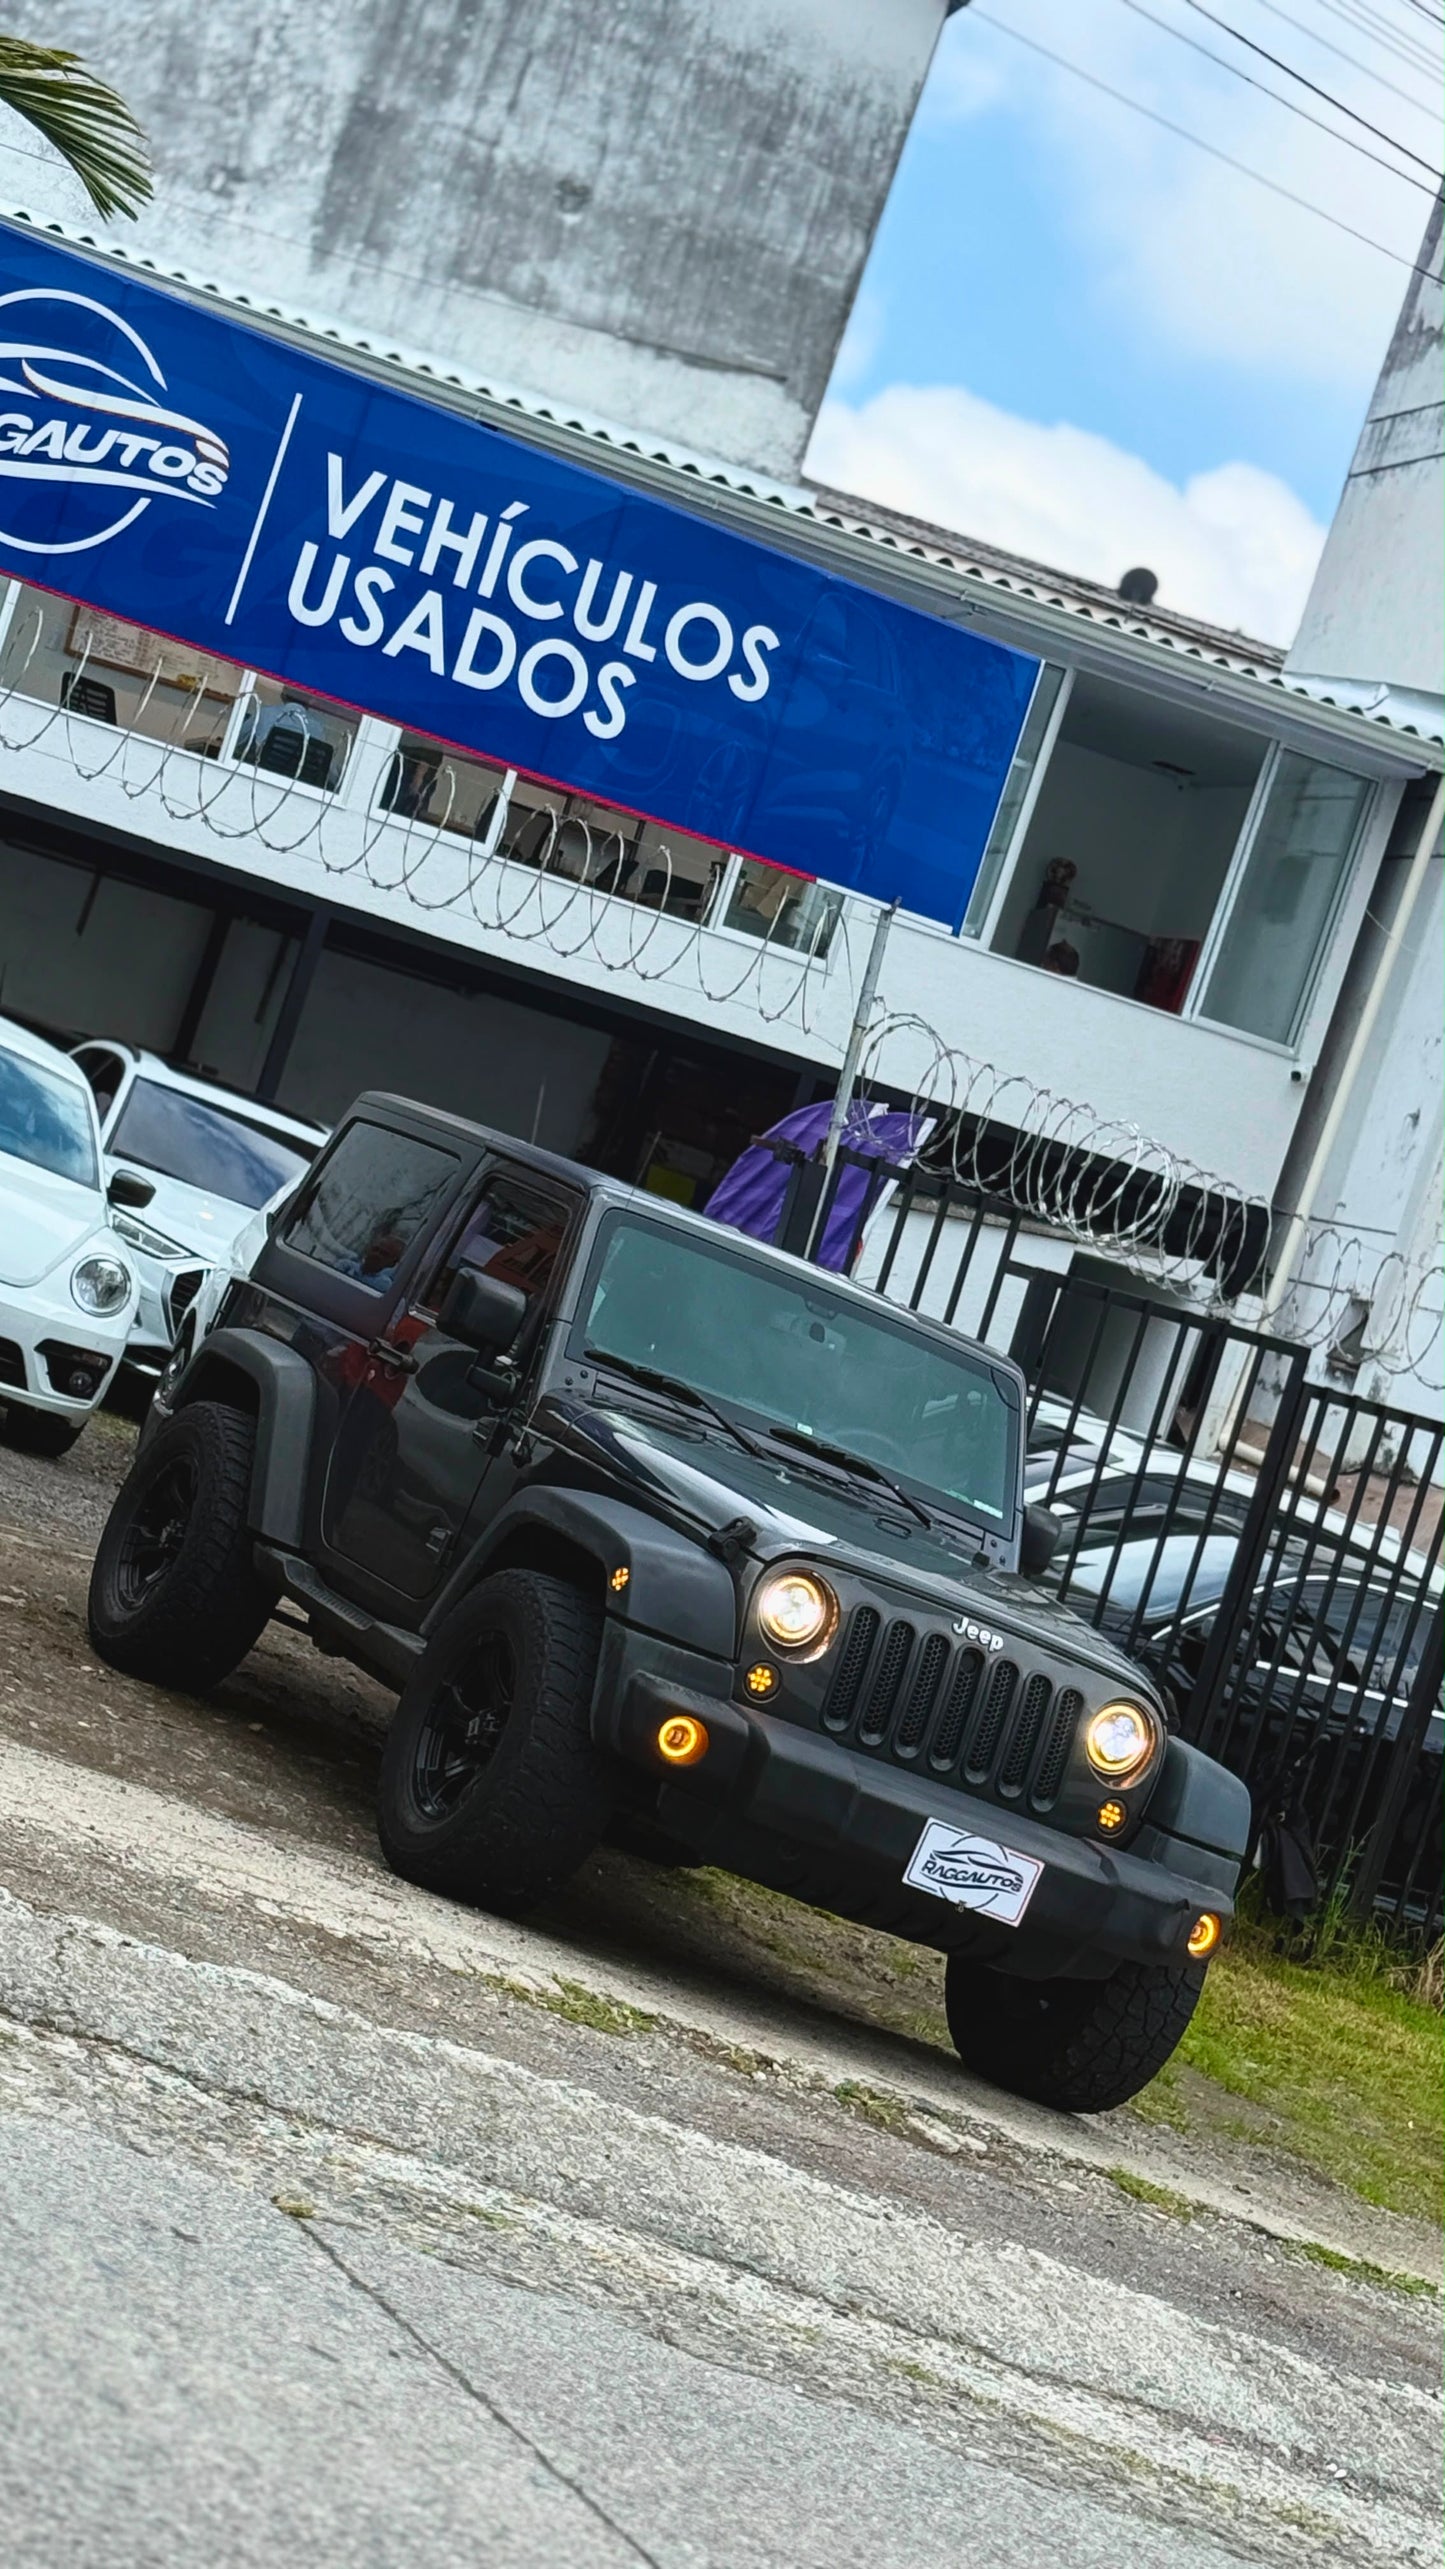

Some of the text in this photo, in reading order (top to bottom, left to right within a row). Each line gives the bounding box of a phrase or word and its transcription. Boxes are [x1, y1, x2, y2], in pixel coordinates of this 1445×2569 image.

[328, 452, 780, 702] VEHÍCULOS
[288, 541, 637, 739] USADOS
[952, 1616, 1004, 1652] Jeep
[921, 1859, 1023, 1893] RAGGAUTOS
